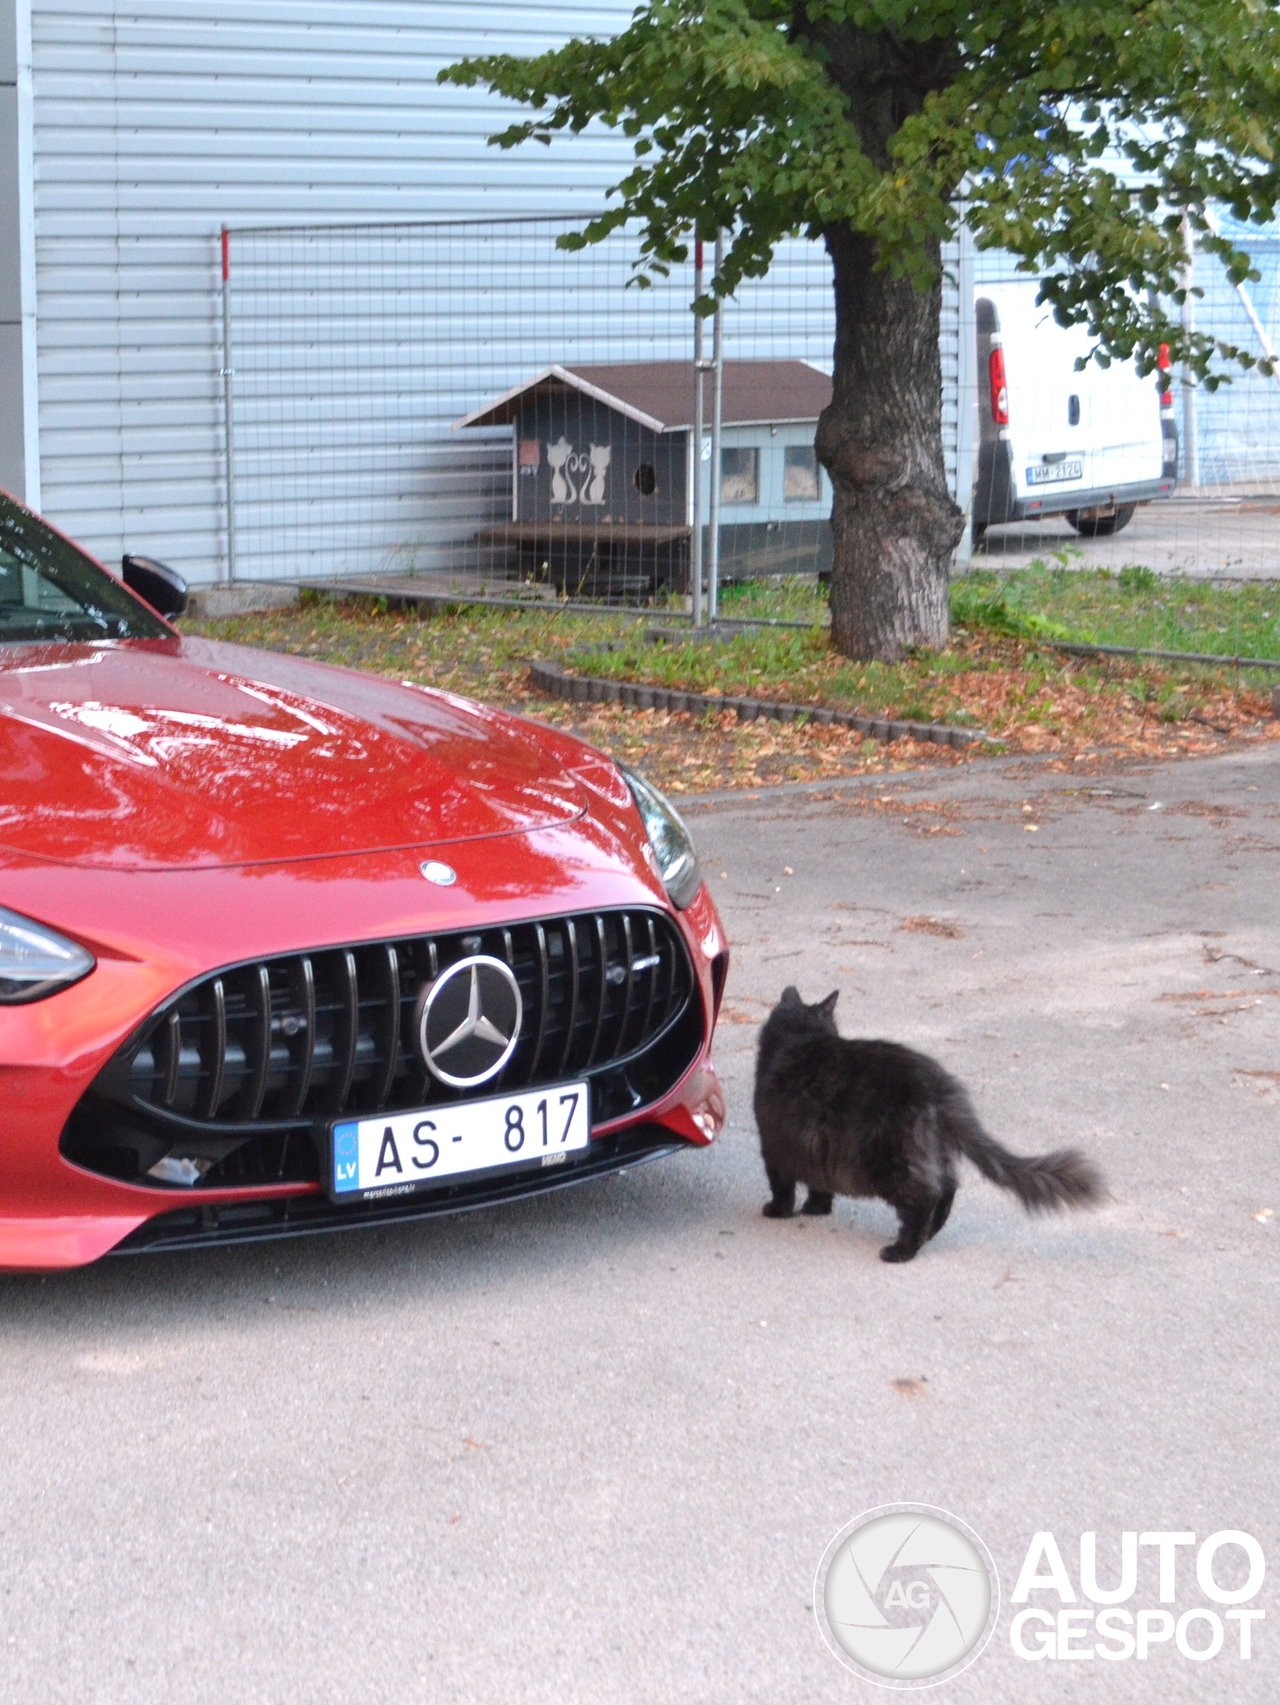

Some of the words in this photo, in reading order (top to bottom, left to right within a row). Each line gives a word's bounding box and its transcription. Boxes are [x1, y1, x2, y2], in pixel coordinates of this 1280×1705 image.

[1034, 463, 1079, 478] MM-2124
[375, 1120, 462, 1177] AS-
[504, 1093, 579, 1152] 817
[337, 1162, 356, 1180] LV
